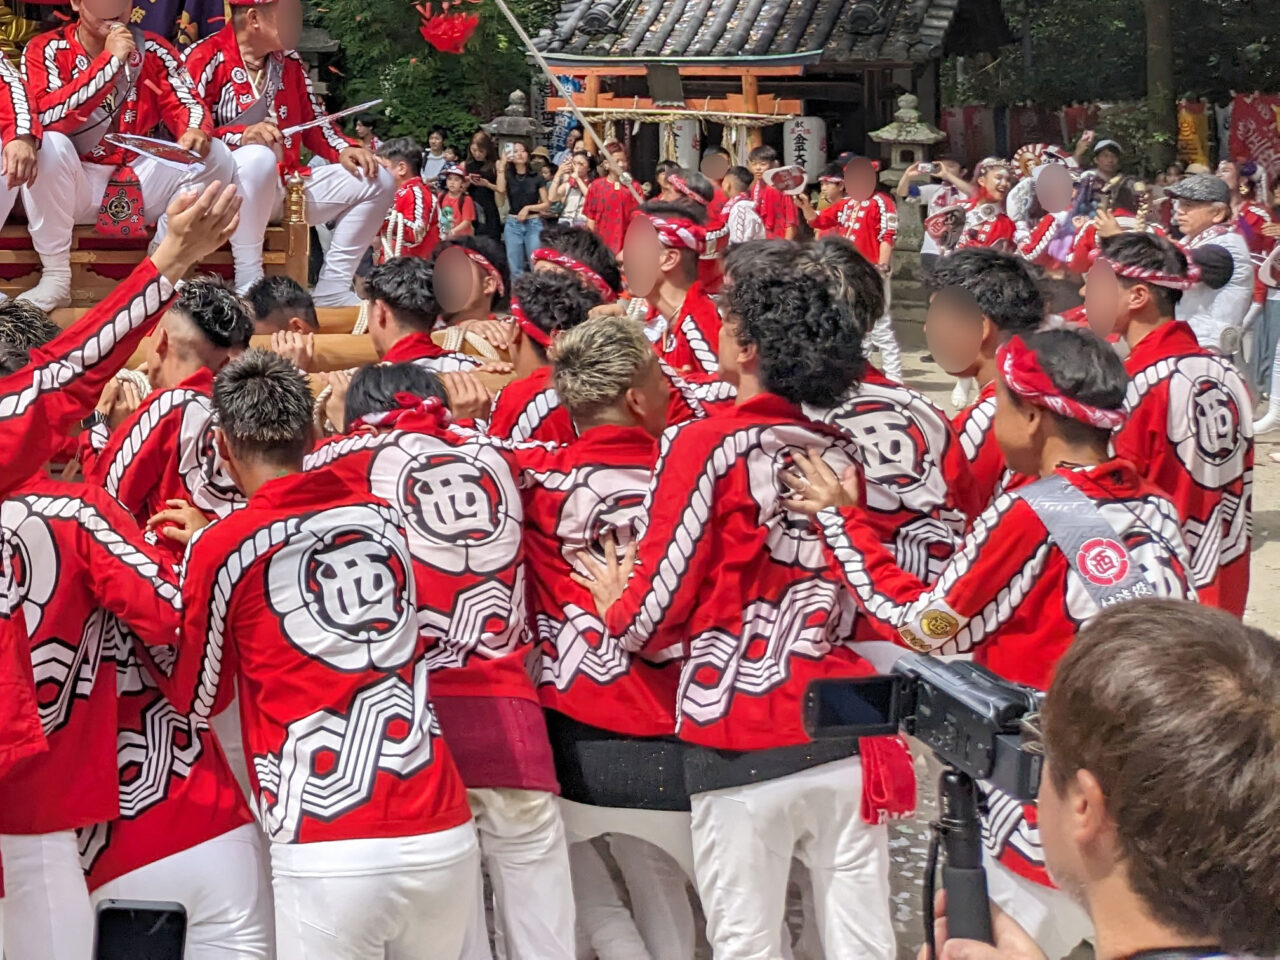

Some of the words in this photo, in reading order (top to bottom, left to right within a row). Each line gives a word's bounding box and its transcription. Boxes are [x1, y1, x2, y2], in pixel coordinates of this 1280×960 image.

[835, 412, 920, 483] 西
[1195, 388, 1236, 456] 西
[414, 460, 498, 538] 西
[317, 541, 405, 628] 西
[1090, 550, 1117, 574] 西
